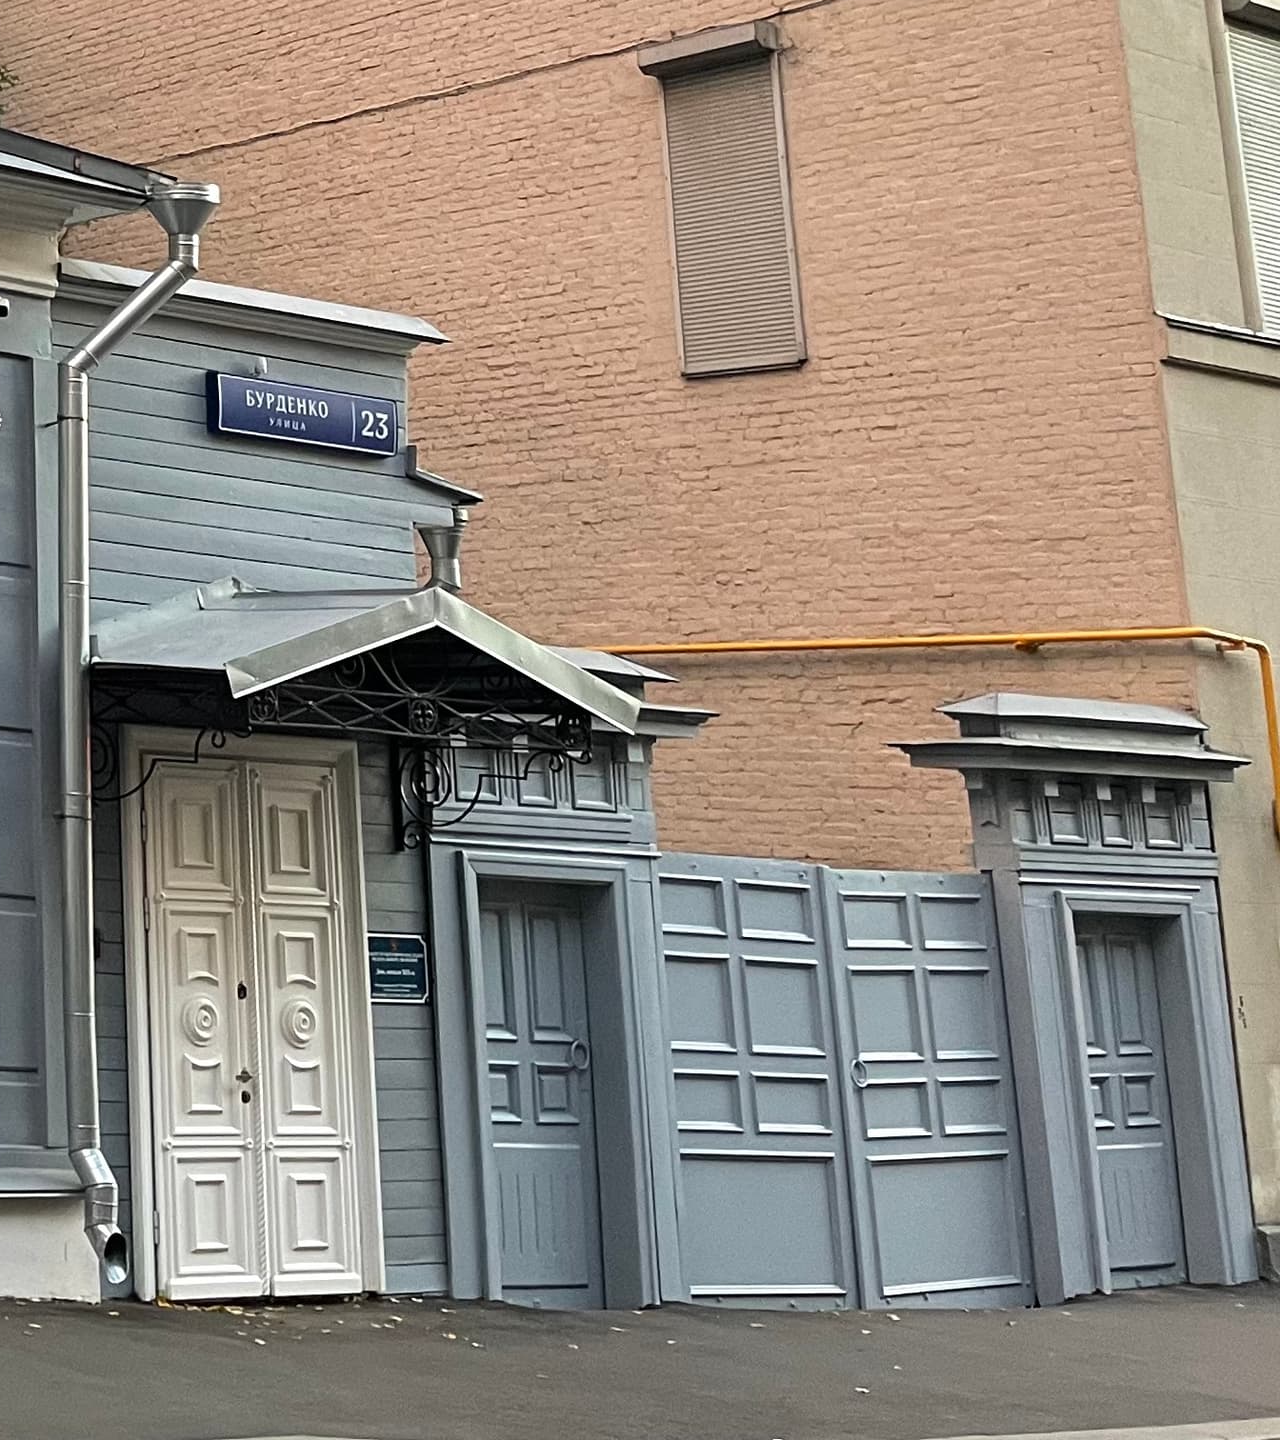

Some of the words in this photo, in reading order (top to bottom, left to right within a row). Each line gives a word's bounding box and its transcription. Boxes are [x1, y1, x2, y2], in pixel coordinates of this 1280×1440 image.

[246, 389, 328, 418] БУРДЕНКО
[269, 417, 306, 431] УЛИЦА
[361, 410, 389, 440] 23
